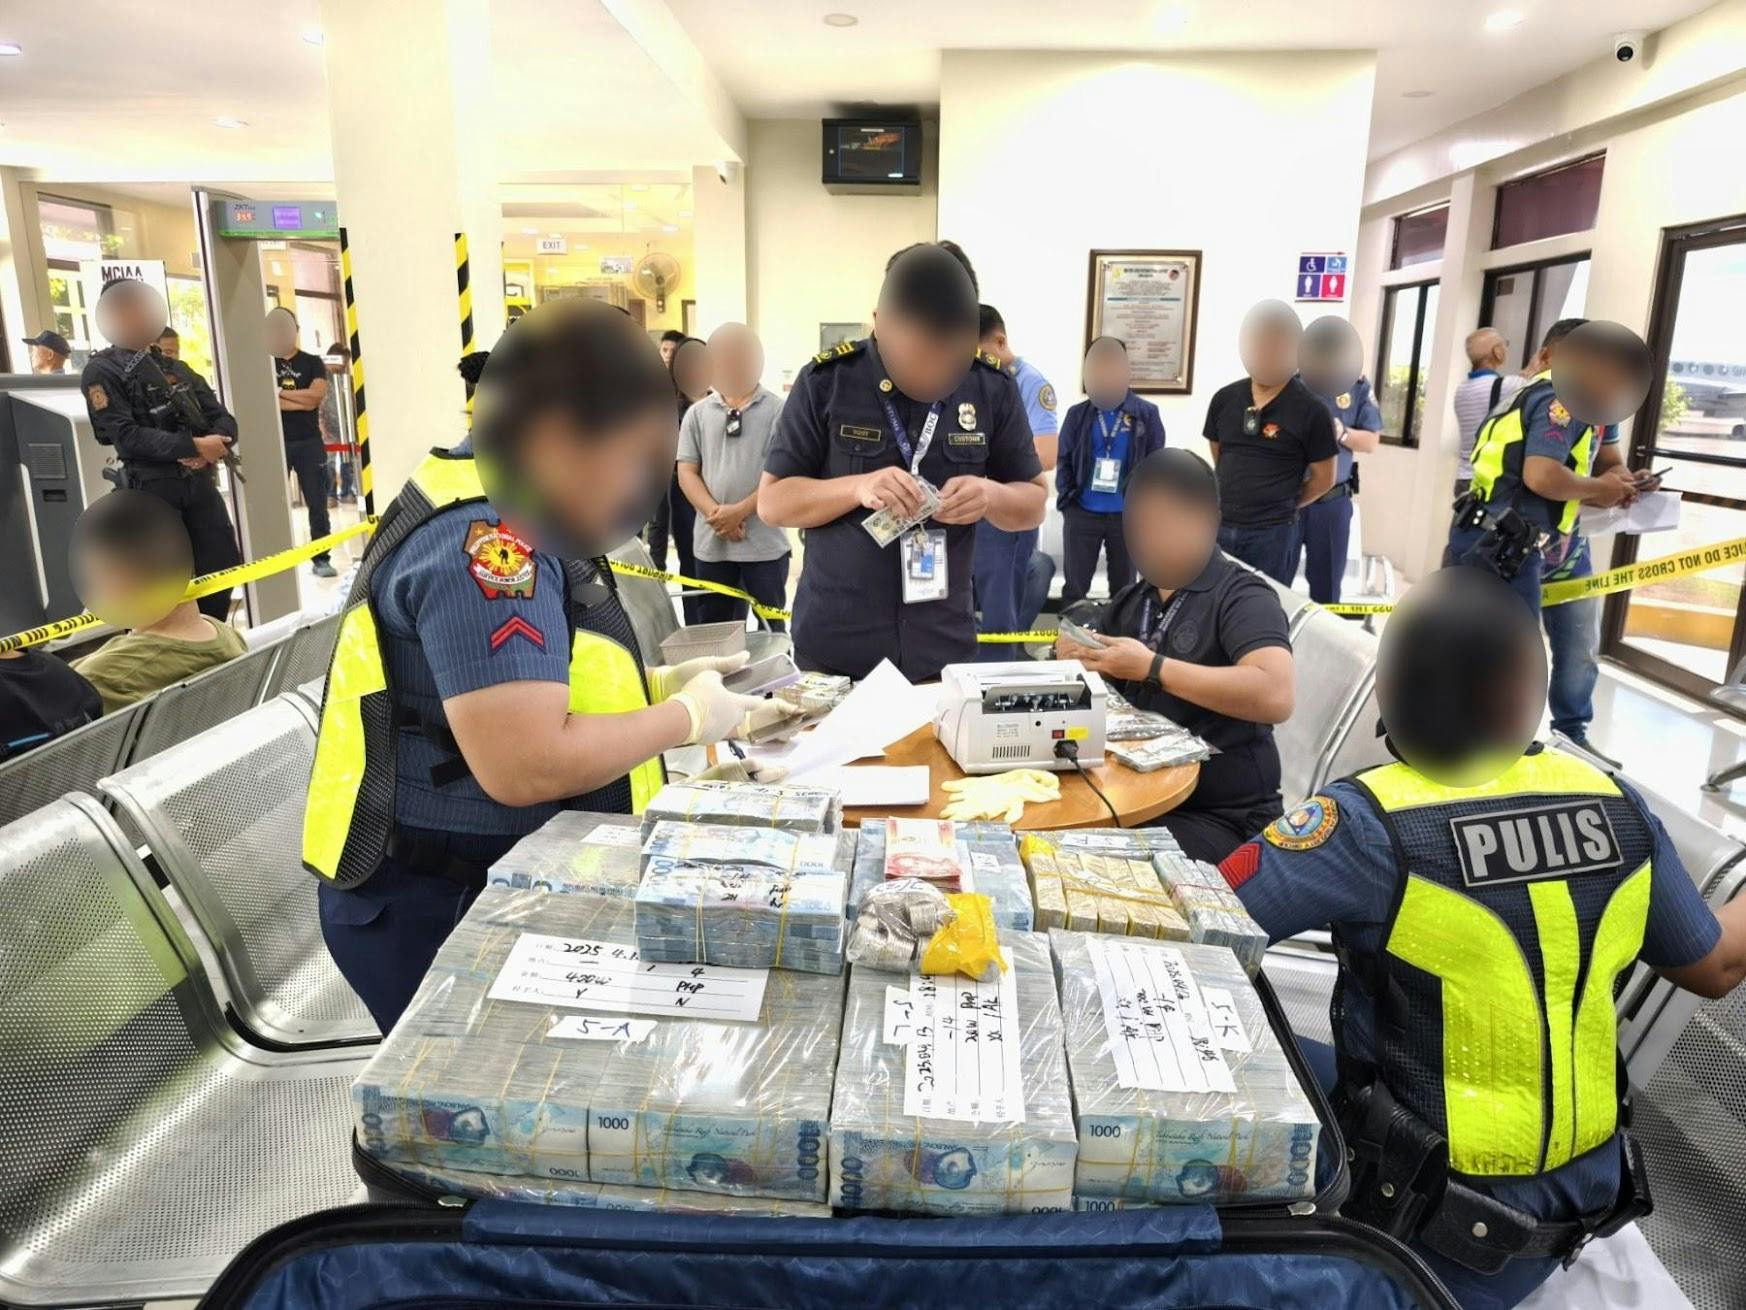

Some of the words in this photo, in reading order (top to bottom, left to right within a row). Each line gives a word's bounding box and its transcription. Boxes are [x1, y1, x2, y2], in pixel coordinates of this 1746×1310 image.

[542, 241, 561, 249] EXIT
[101, 266, 142, 281] MCIAA
[924, 414, 938, 436] BOC
[1462, 809, 1610, 877] PULIS
[563, 943, 603, 956] 2025
[1211, 1001, 1240, 1037] 5-K
[577, 1020, 631, 1038] 5-A
[598, 1116, 630, 1130] 1000
[1090, 1124, 1122, 1138] 1000
[549, 1166, 580, 1178] 1000
[1085, 1200, 1116, 1212] 1000
